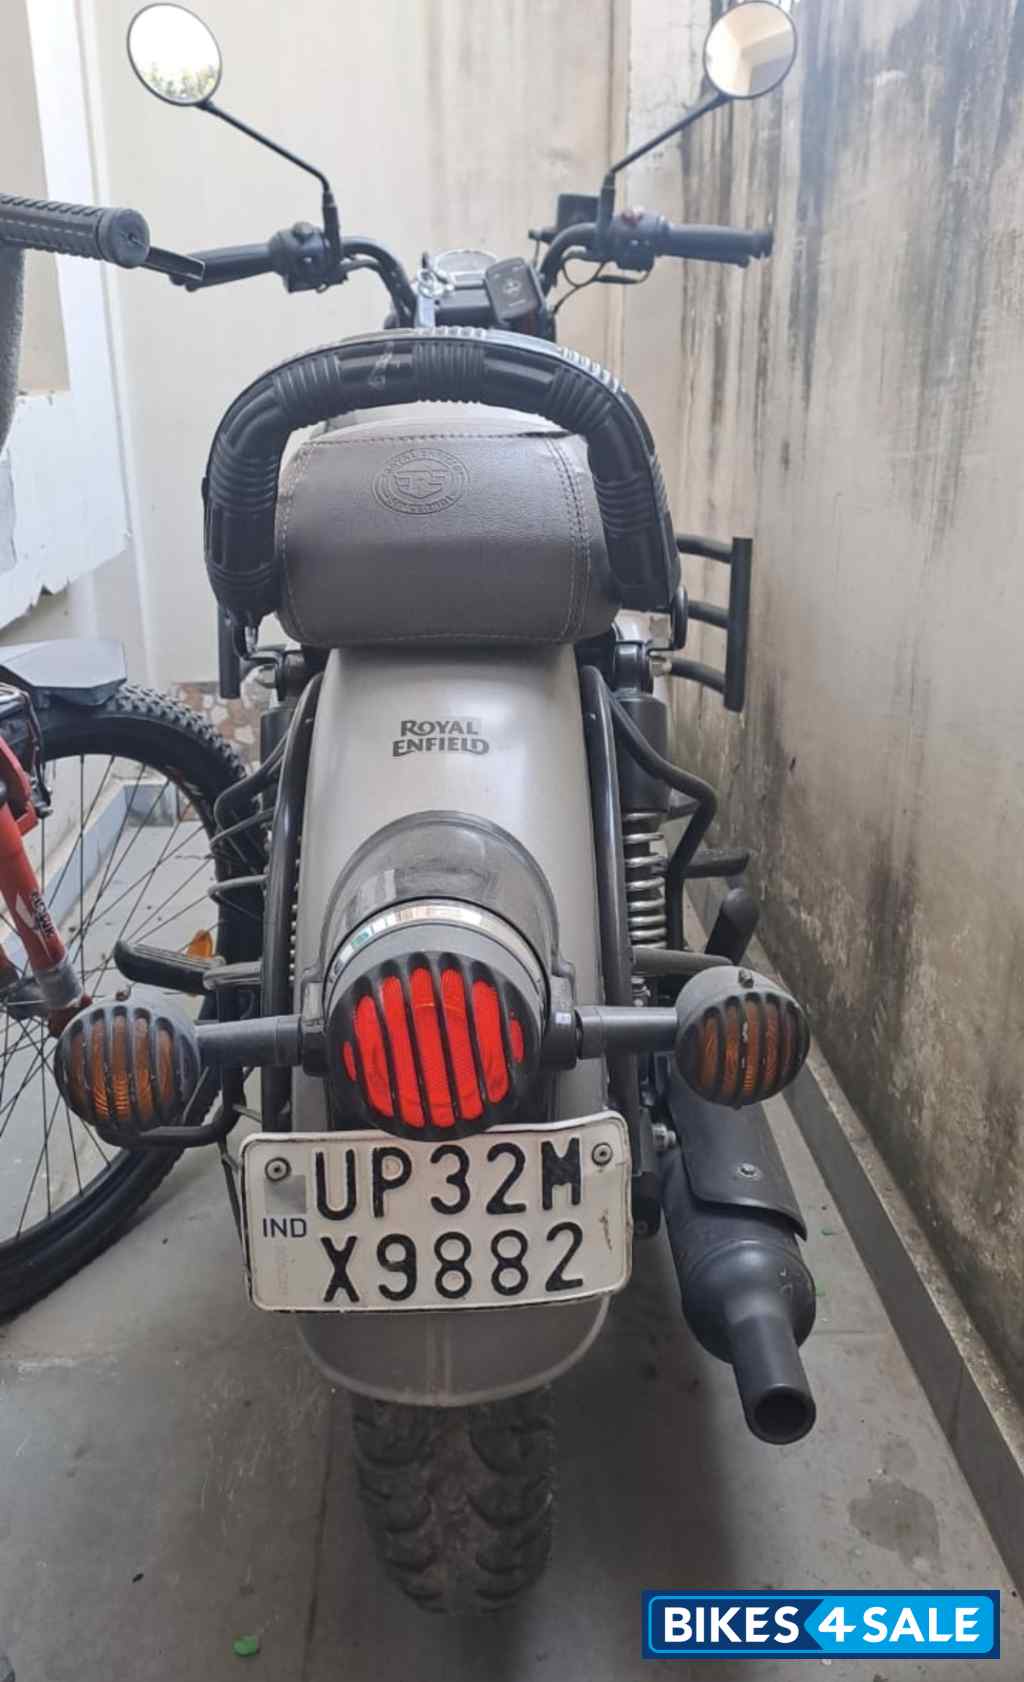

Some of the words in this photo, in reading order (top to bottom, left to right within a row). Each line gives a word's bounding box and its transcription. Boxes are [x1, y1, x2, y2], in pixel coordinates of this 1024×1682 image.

[400, 720, 479, 737] ROYAL
[392, 737, 490, 757] ENFIELD
[262, 1217, 307, 1239] IND
[320, 1221, 584, 1303] X9882
